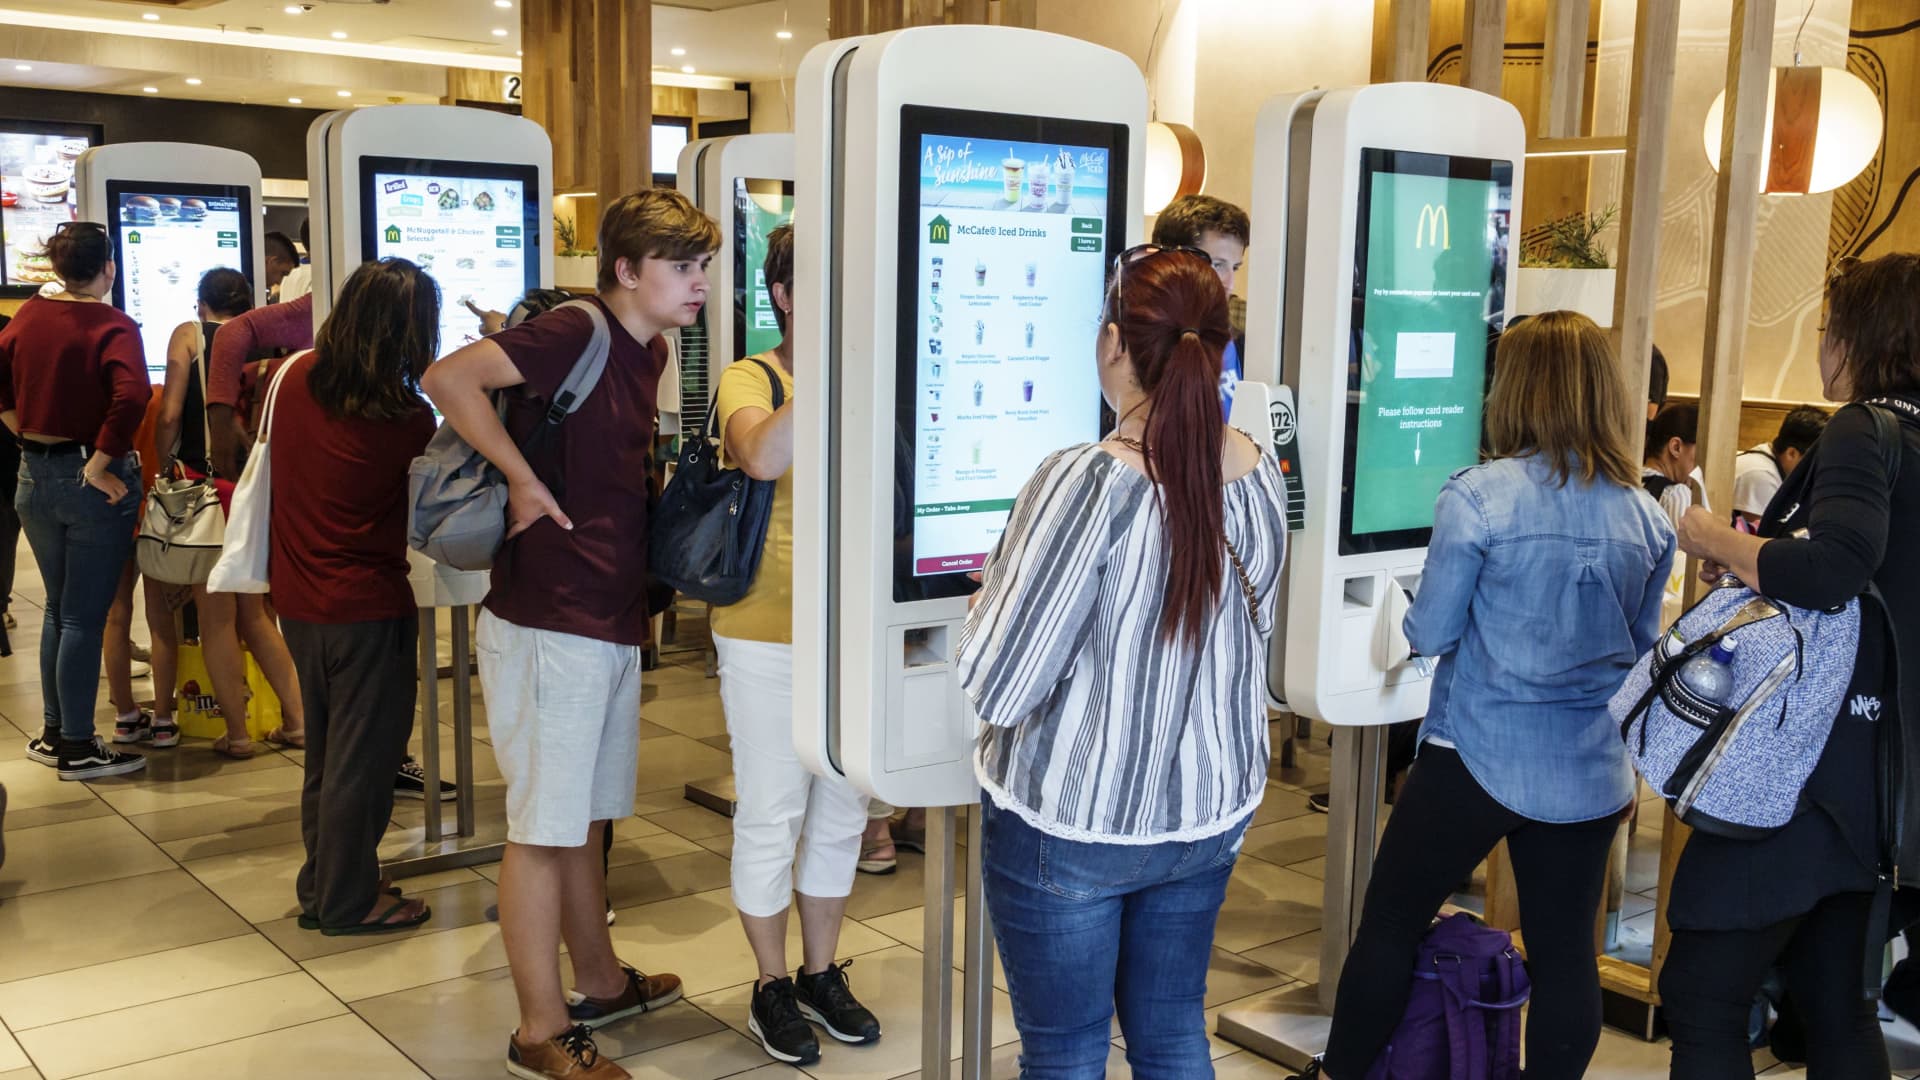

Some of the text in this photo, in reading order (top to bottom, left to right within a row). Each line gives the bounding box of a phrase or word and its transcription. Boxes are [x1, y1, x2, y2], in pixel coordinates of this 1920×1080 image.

[924, 142, 976, 168] A Sip of
[934, 160, 998, 186] Sunshine
[998, 226, 1017, 236] Iced
[1019, 227, 1047, 238] Drinks
[1378, 404, 1464, 416] Please follow card reader
[1271, 412, 1291, 427] 172
[1400, 418, 1442, 429] instructions
[926, 505, 940, 513] Order
[944, 505, 956, 513] Take
[957, 504, 970, 512] Away
